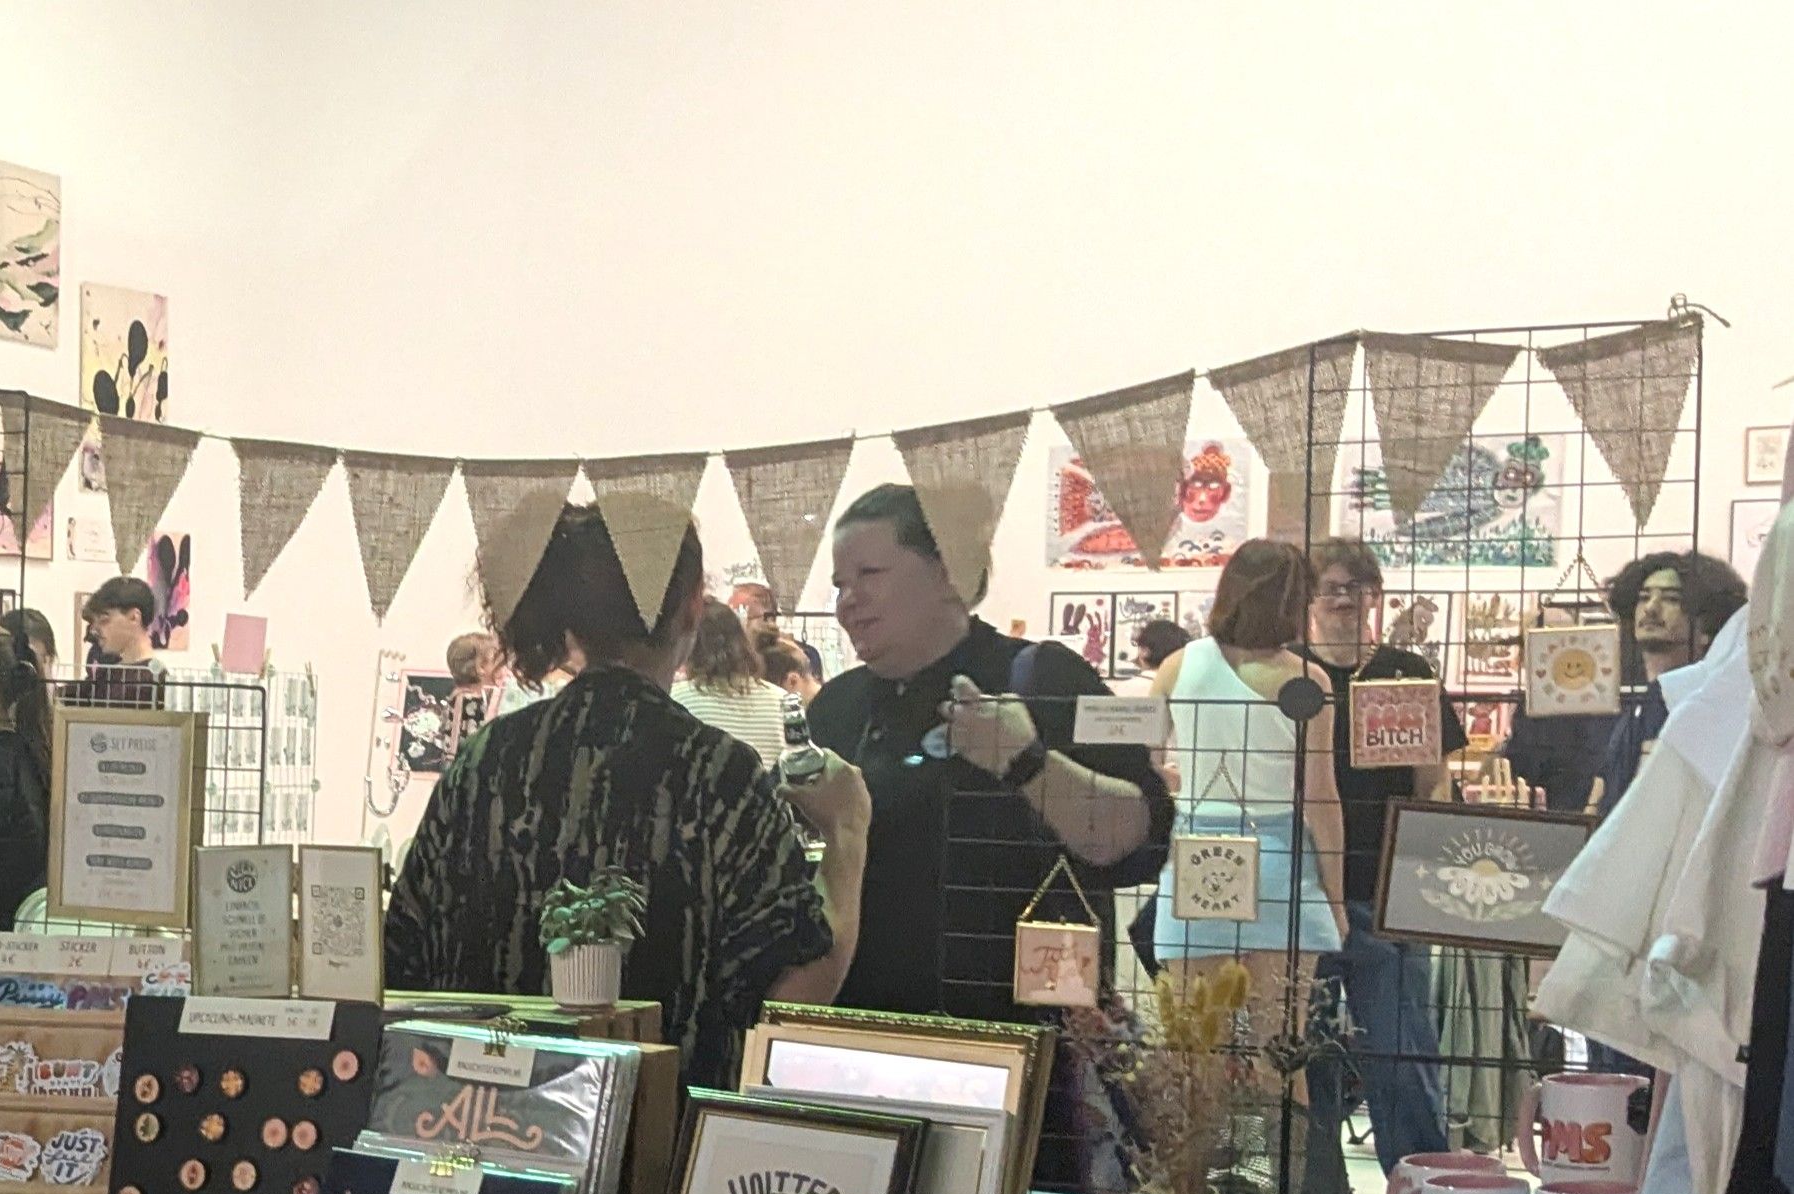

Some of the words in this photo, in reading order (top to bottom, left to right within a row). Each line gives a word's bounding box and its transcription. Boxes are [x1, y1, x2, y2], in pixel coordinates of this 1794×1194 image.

[1366, 727, 1423, 747] BITCH
[1190, 845, 1245, 866] GREEN
[1191, 893, 1239, 911] HEART
[51, 1133, 102, 1153] JUST
[56, 1162, 79, 1178] IT
